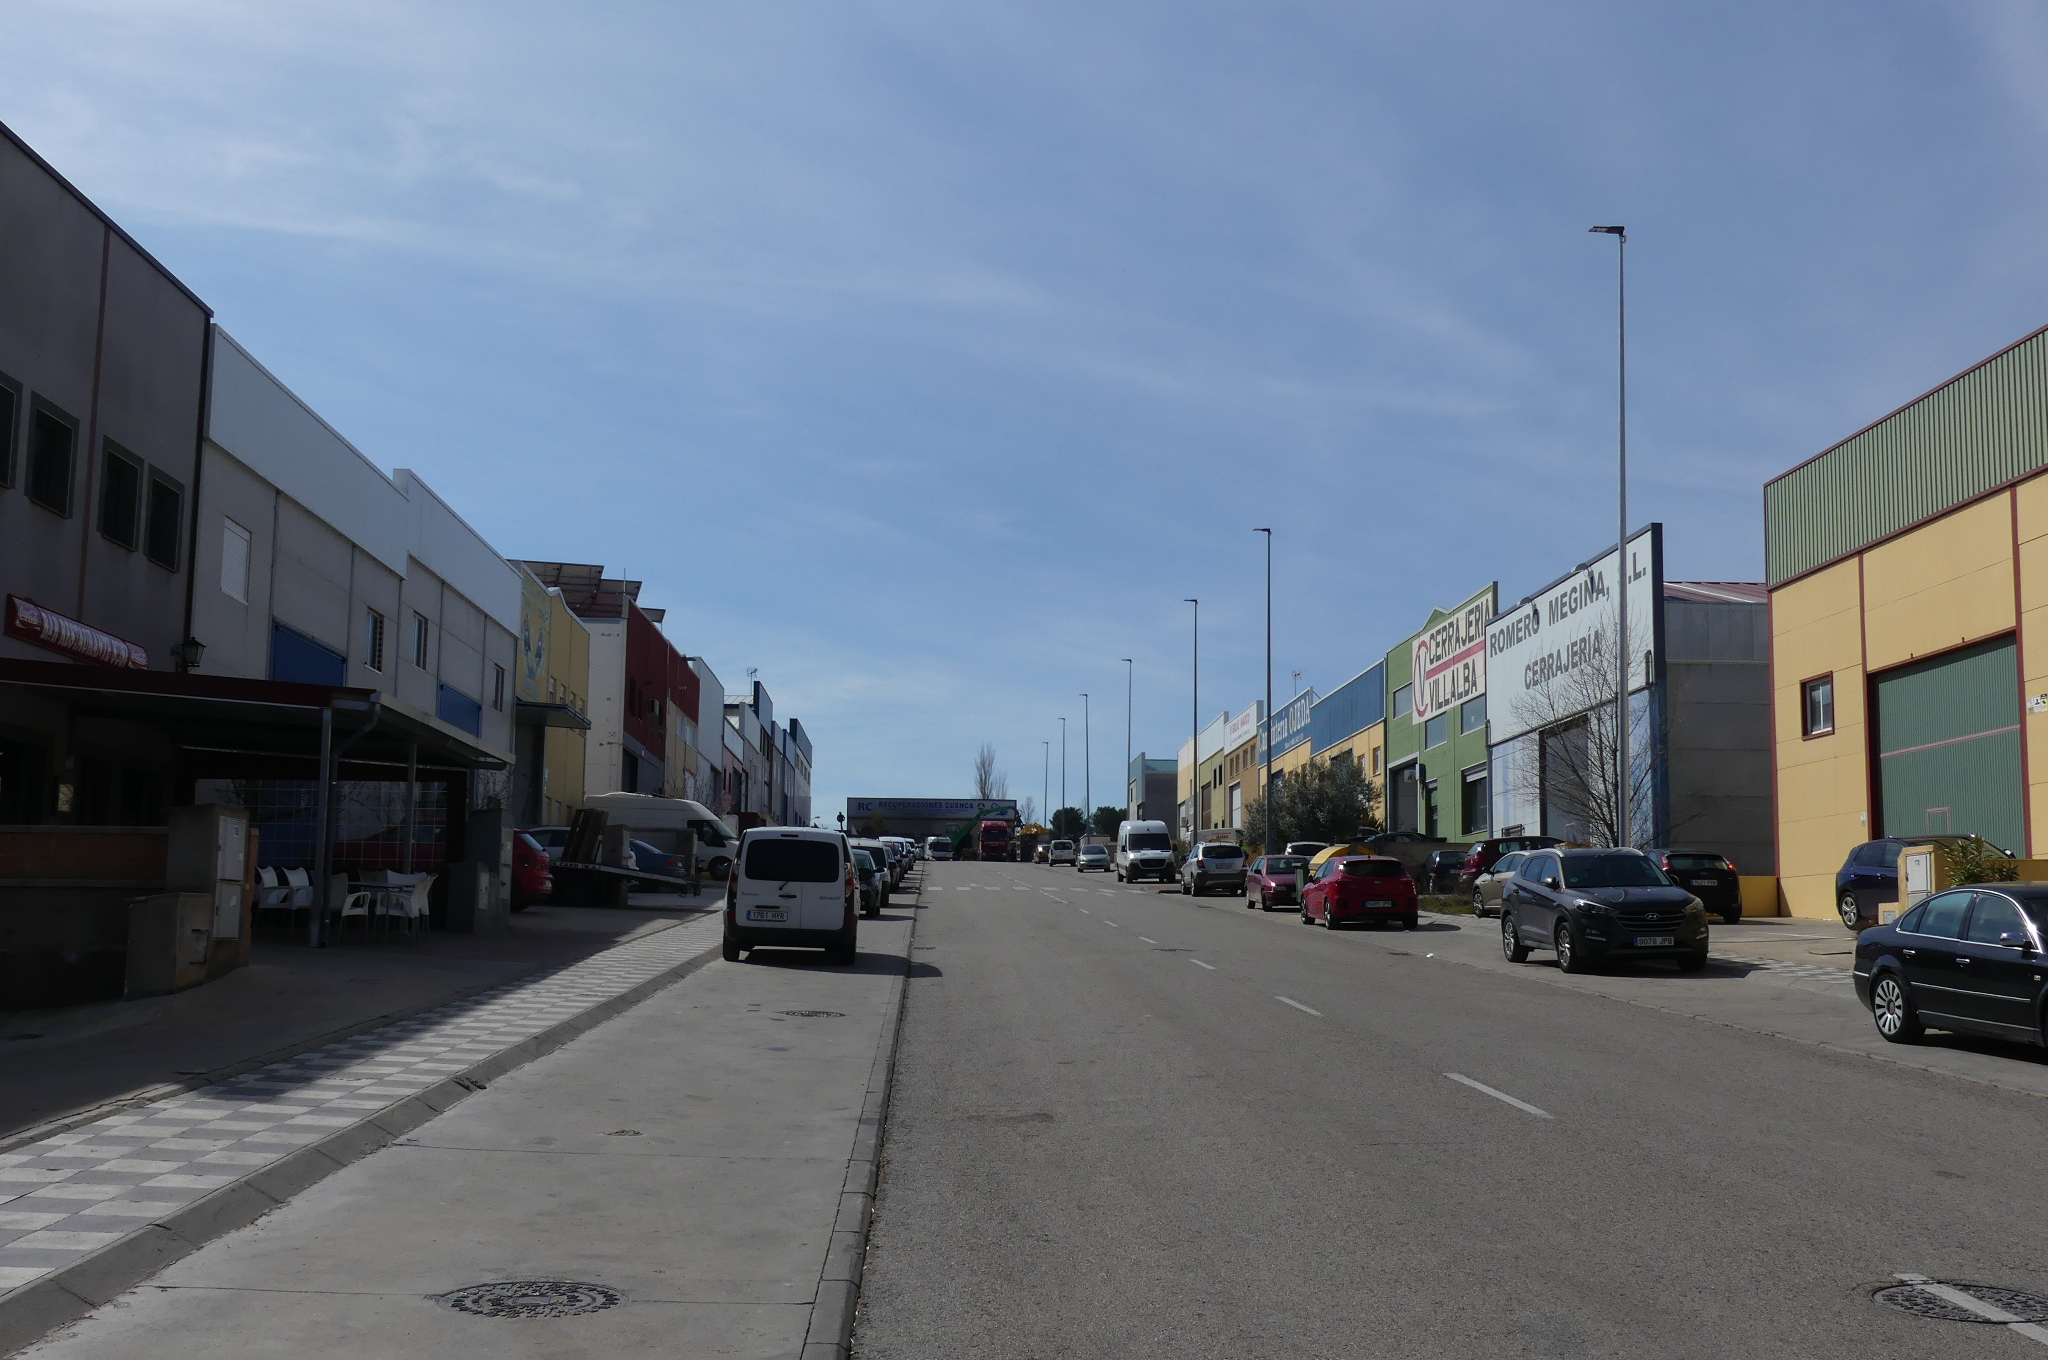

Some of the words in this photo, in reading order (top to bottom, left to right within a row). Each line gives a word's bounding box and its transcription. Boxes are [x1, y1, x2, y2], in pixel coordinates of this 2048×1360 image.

[1490, 608, 1540, 658] ROMERO
[1429, 659, 1478, 713] VILLALBA
[1288, 696, 1311, 734] OJEDA
[857, 802, 873, 811] RC
[878, 801, 943, 809] RECUPERACIONES
[753, 911, 768, 919] 1761
[1659, 937, 1673, 945] JPB
